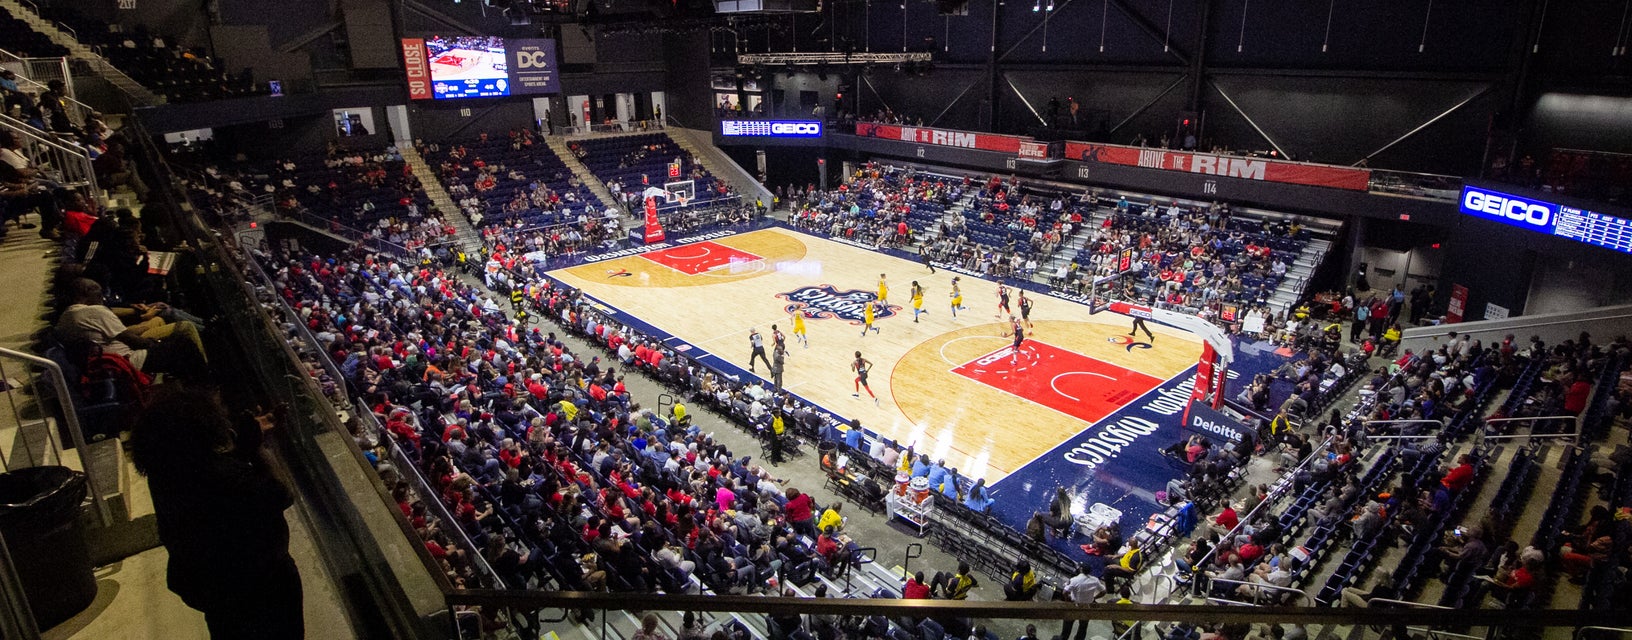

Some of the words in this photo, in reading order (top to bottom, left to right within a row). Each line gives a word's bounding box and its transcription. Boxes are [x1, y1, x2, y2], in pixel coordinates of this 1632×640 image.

[403, 44, 423, 77] CLOSE
[516, 51, 547, 69] DC
[410, 81, 426, 95] SO
[771, 123, 819, 134] GEICO
[932, 130, 976, 149] RIM
[1018, 148, 1044, 157] HERE
[1078, 167, 1089, 179] 113
[1137, 149, 1166, 169] ABOVE
[1173, 154, 1185, 170] THE
[1190, 154, 1266, 181] RIM
[1204, 182, 1217, 195] 114
[1464, 190, 1550, 226] GEICO
[1193, 415, 1243, 442] Deloitte
